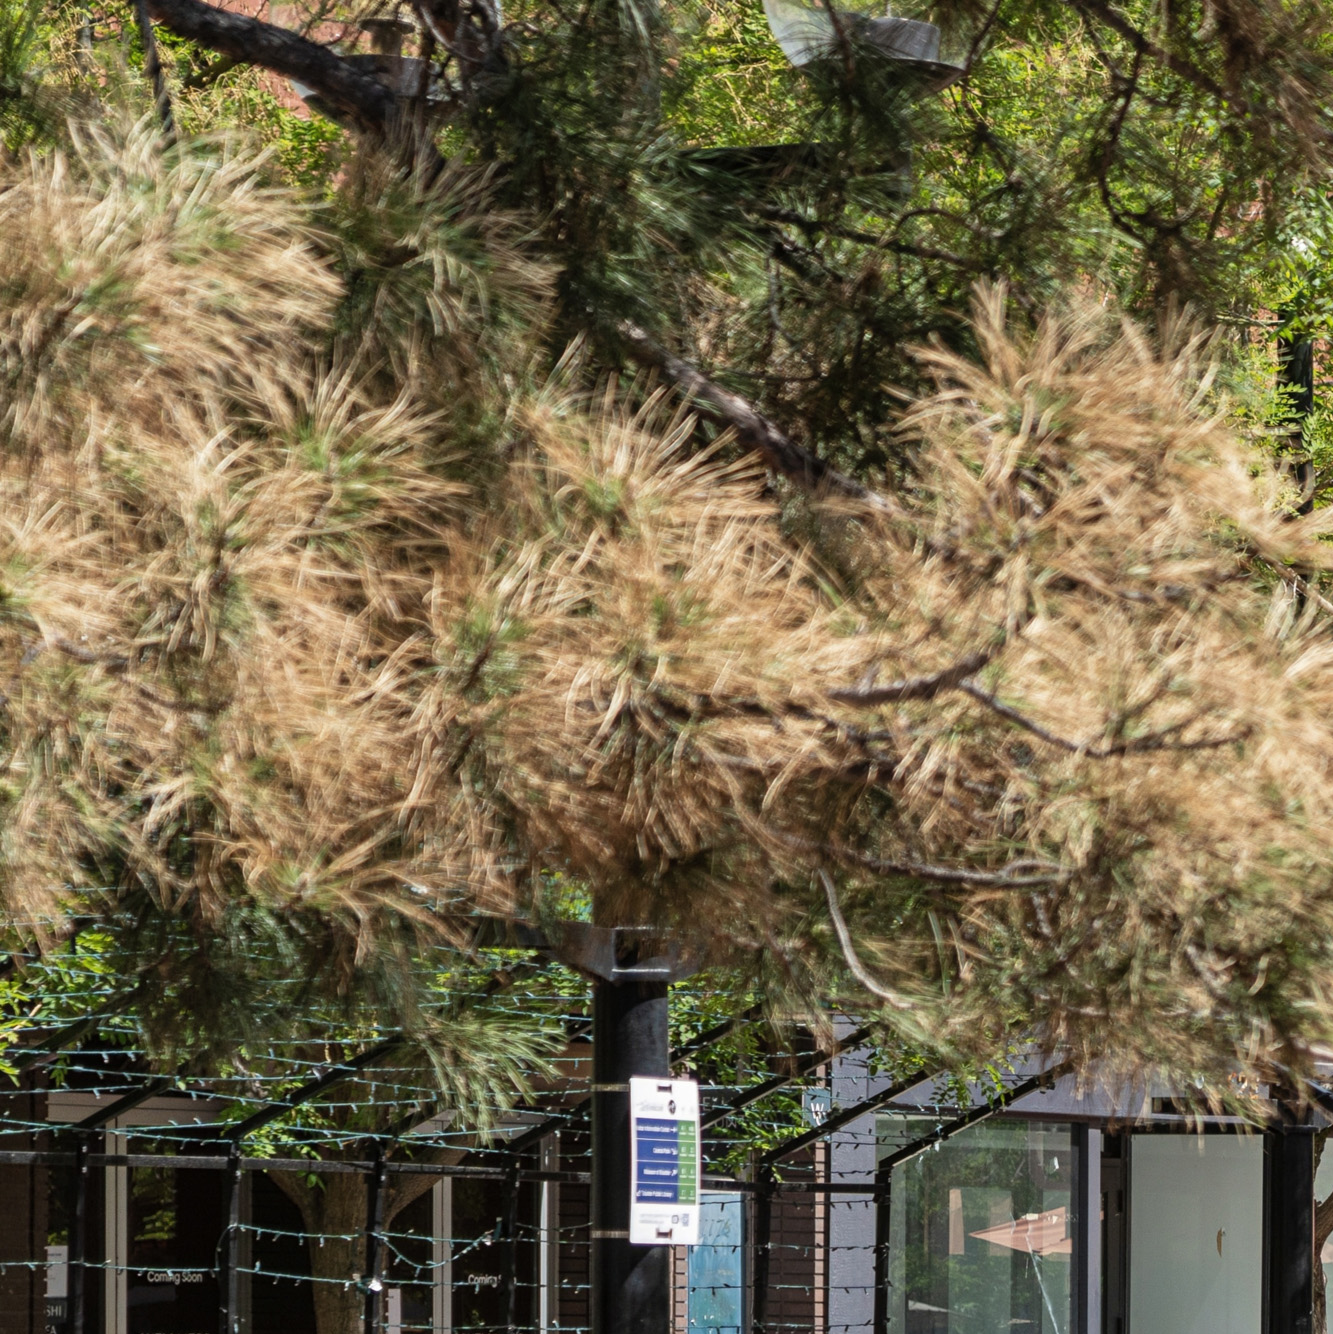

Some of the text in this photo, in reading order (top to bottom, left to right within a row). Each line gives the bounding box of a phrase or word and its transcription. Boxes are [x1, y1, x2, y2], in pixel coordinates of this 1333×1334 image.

[147, 1271, 203, 1285] Coming Soon
[468, 1274, 497, 1288] Coming
